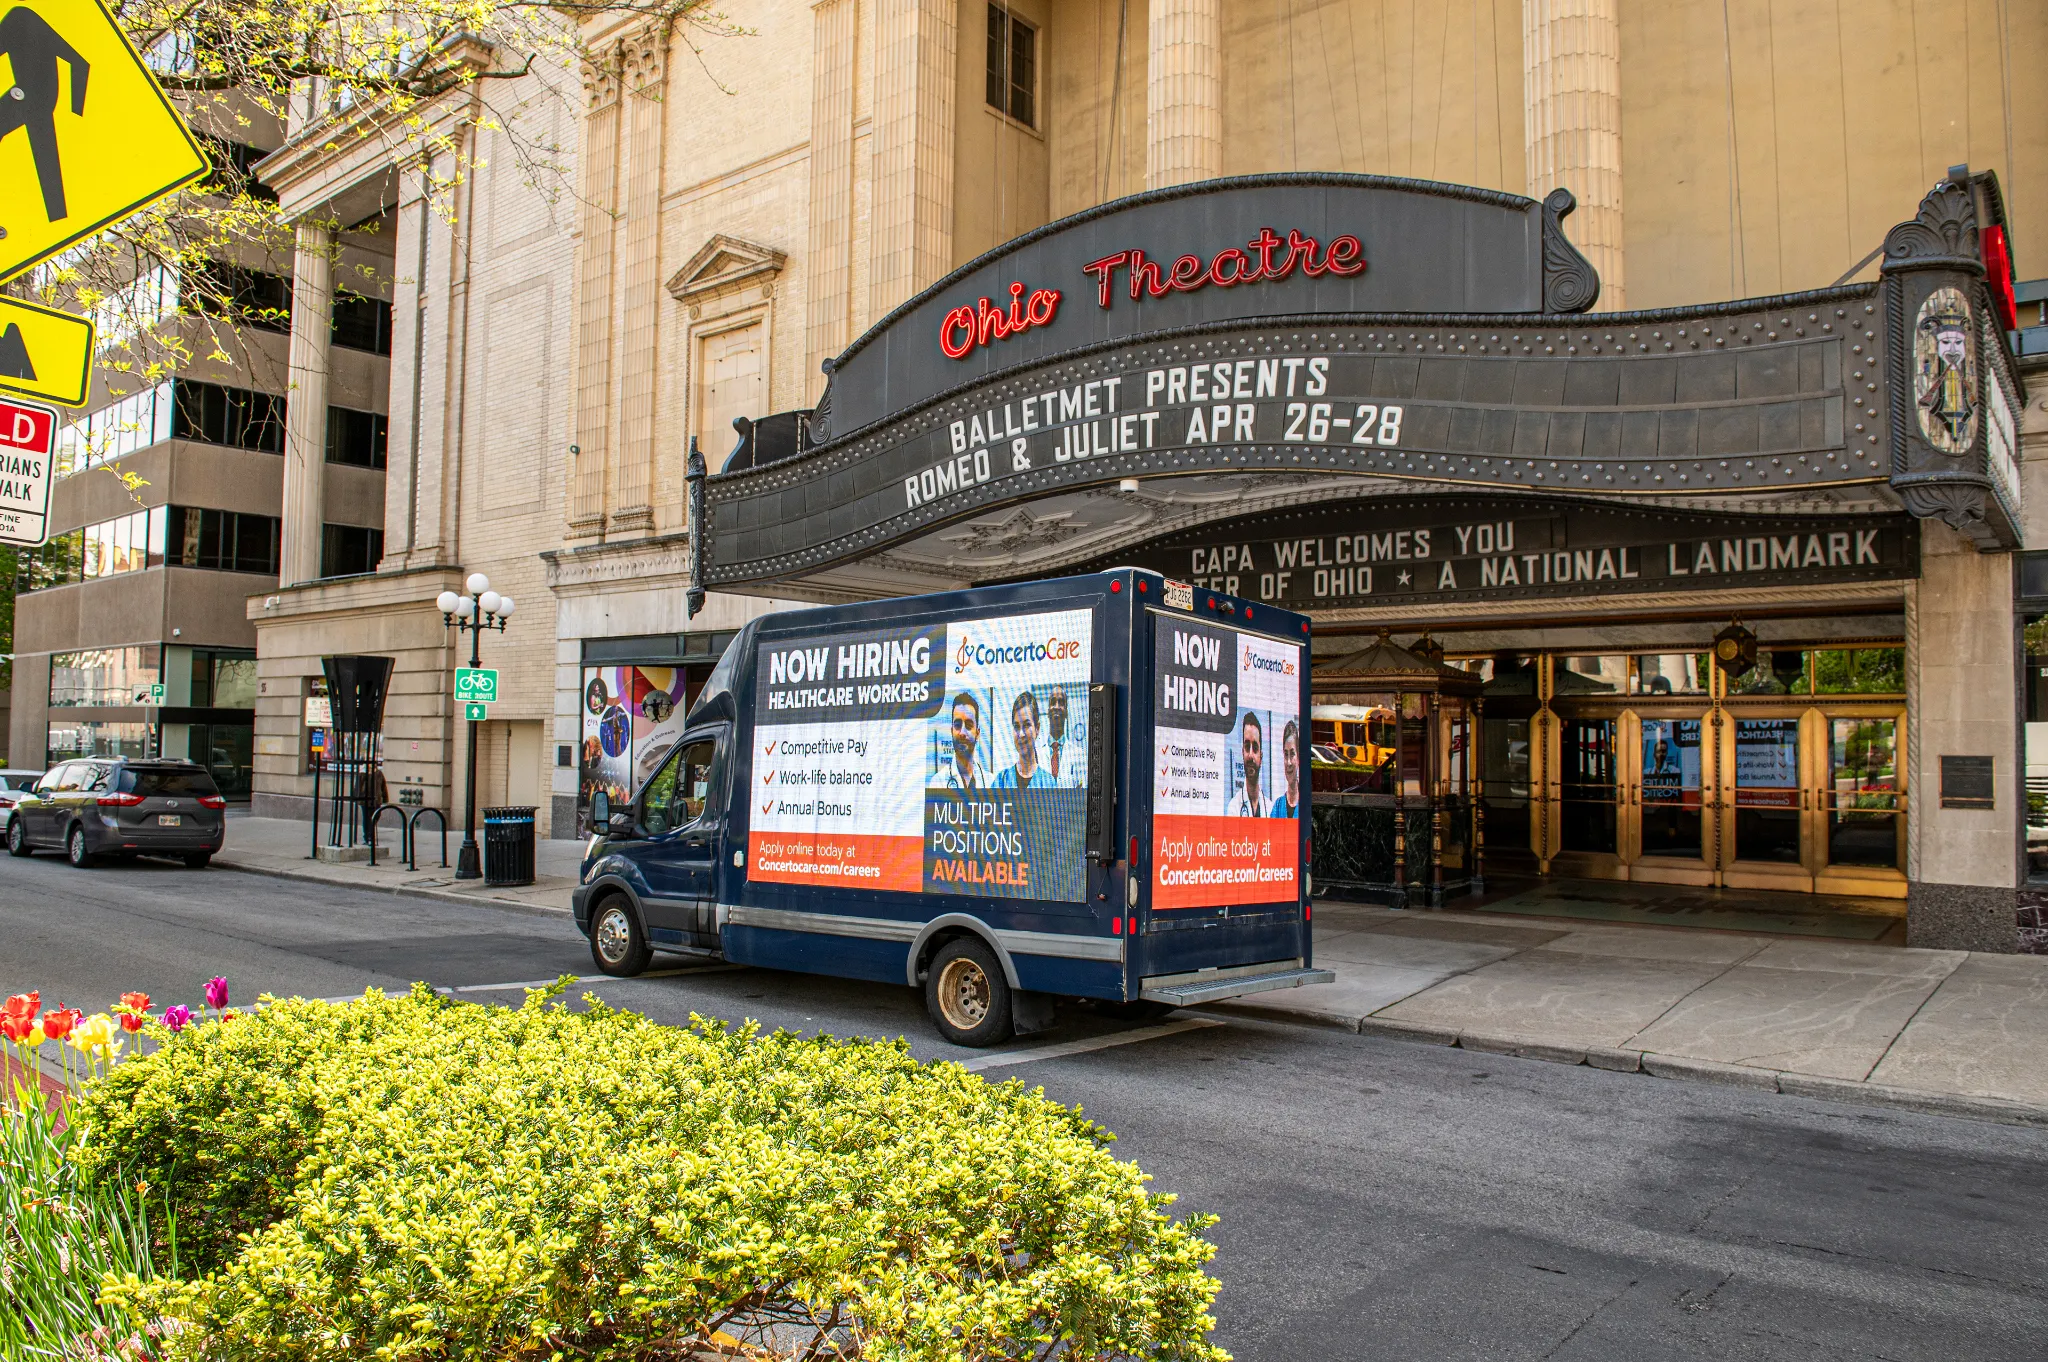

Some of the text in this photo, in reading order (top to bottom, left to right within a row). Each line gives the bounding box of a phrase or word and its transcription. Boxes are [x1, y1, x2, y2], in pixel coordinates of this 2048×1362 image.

[939, 227, 1366, 359] Ohio Theatre
[949, 357, 1330, 455] BALLETMET PRESENTS
[905, 402, 1404, 509] ROMEO & JULIET APR 26-28
[1192, 521, 1514, 575] CAPA WELCOMES YOU
[1260, 571, 1292, 600] OF
[1313, 567, 1373, 597] OHIO
[1437, 560, 1457, 590] A
[1481, 547, 1639, 587] NATIONAL
[1668, 528, 1879, 575] LANDMARK
[769, 637, 930, 685] NOW HIRING
[975, 637, 1079, 666] ConcertoCare
[1174, 630, 1221, 672] NOW
[1252, 653, 1295, 676] ConcertoCare
[154, 686, 162, 696] P
[768, 681, 930, 710] HEALTHCARE WORKERS
[1164, 674, 1230, 717] HIRING
[634, 740, 652, 760] Education
[654, 729, 676, 740] Outreach
[780, 738, 868, 758] Competitive Pay
[1170, 745, 1216, 762] Competitive Pay
[779, 769, 872, 786] Work-life balance
[1170, 766, 1219, 780] Work-life balance
[1170, 788, 1210, 800] Annual Bonus
[777, 800, 852, 816] Annual Bonus
[933, 802, 1013, 825] MULTIPLE
[759, 840, 856, 858] Apply online today at
[933, 830, 1022, 856] POSITIONS
[1160, 836, 1271, 863] Apply online today at
[758, 857, 881, 877] Concertocare.com/careers
[932, 859, 1029, 886] AVAILABLE
[1159, 863, 1294, 886] Concertocare.com/careers
